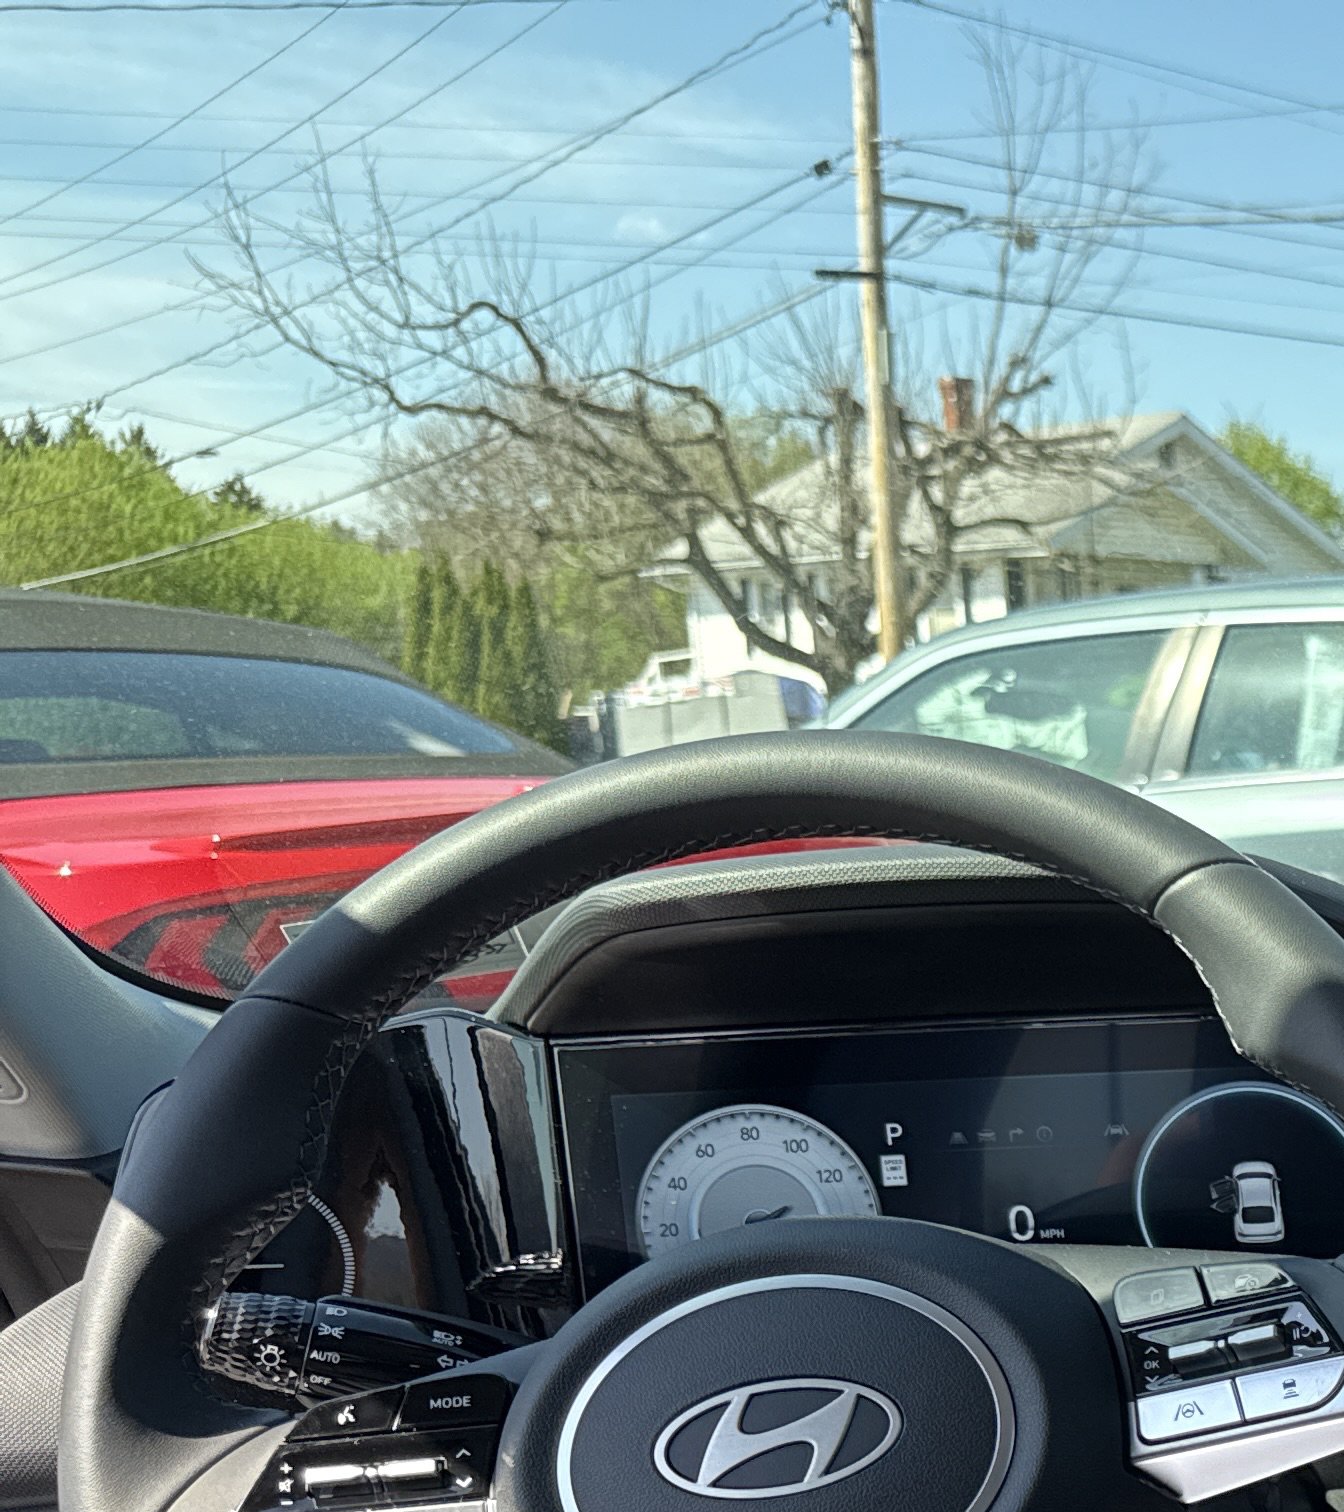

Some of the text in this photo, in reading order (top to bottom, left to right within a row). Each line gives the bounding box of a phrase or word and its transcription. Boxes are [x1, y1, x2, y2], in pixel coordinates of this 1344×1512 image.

[740, 1127, 760, 1141] 80
[885, 1122, 903, 1146] P
[695, 1143, 716, 1159] 60
[782, 1139, 809, 1154] 100
[667, 1176, 688, 1191] 40
[815, 1169, 843, 1184] 120
[1008, 1204, 1065, 1241] 0 MPH
[659, 1223, 679, 1238] 20
[309, 1349, 341, 1365] AUTO
[1143, 1359, 1161, 1370] OK
[309, 1374, 333, 1386] OFF
[429, 1395, 472, 1410] MODE
